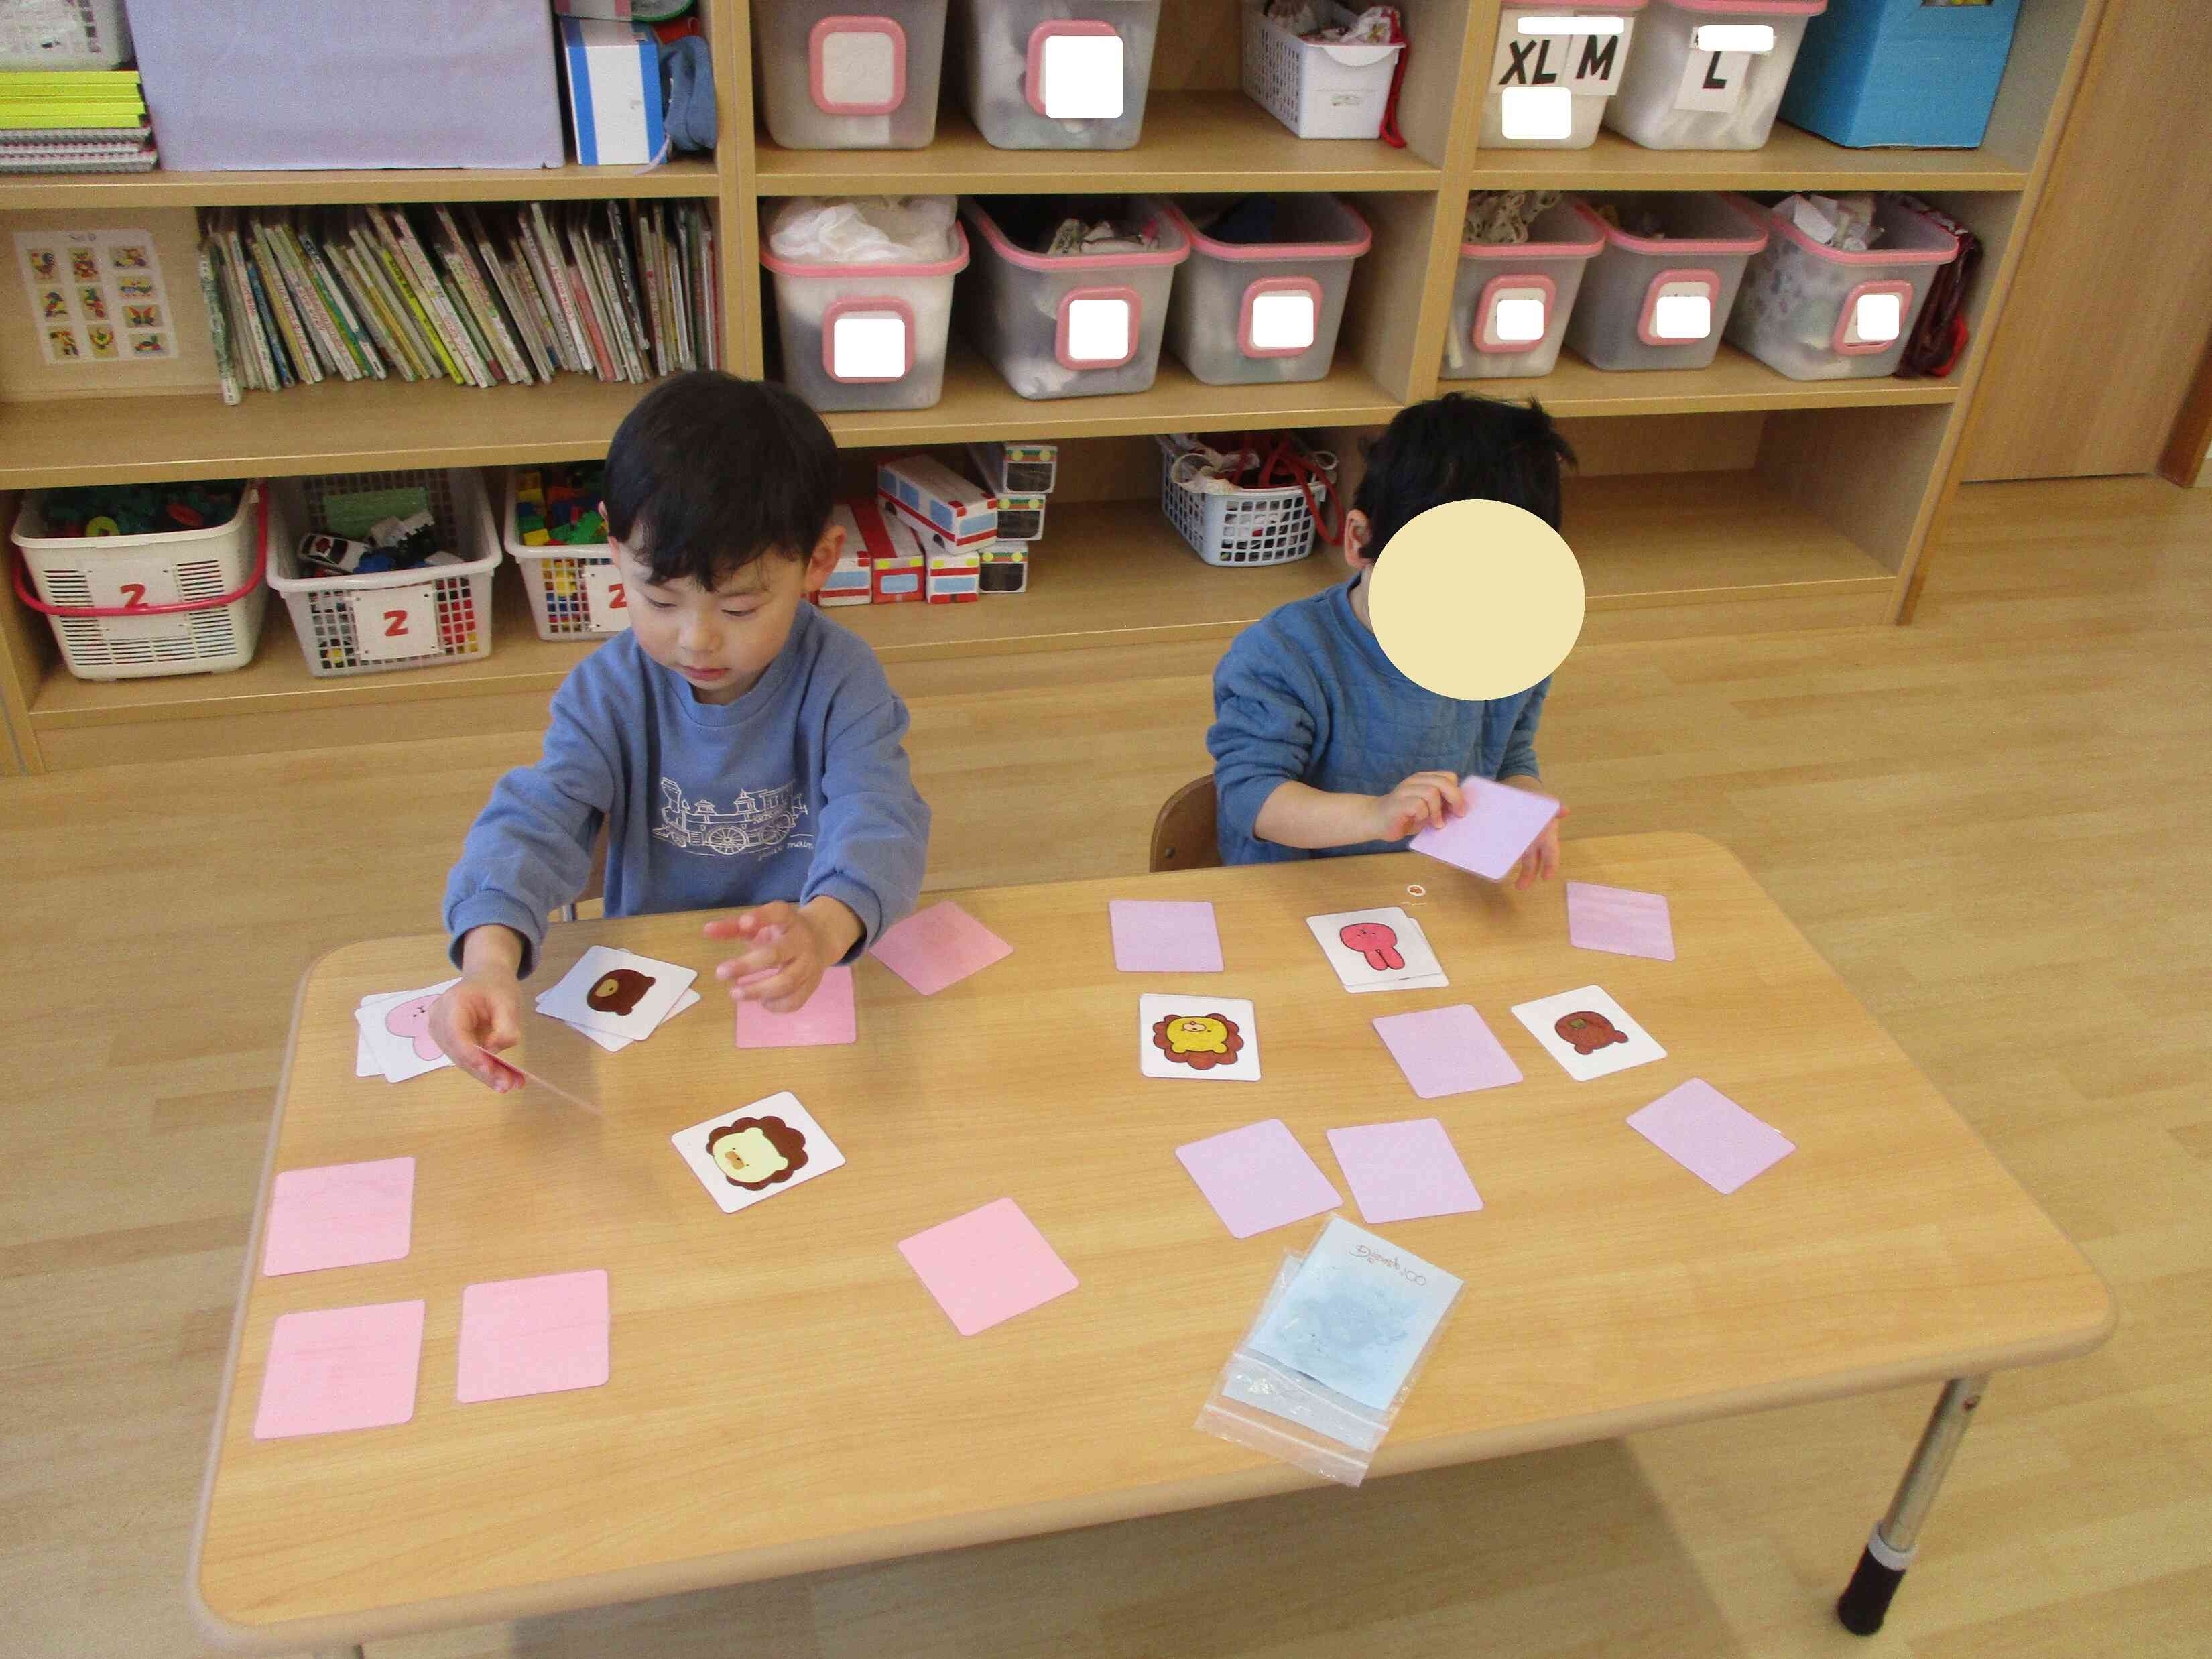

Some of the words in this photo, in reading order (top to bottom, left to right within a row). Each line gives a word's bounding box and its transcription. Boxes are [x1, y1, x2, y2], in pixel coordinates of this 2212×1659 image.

[1497, 39, 1558, 85] XL
[1575, 34, 1619, 80] M
[1702, 50, 1727, 89] L
[120, 583, 149, 609] 2
[608, 583, 627, 609] 2
[383, 609, 408, 637] 2
